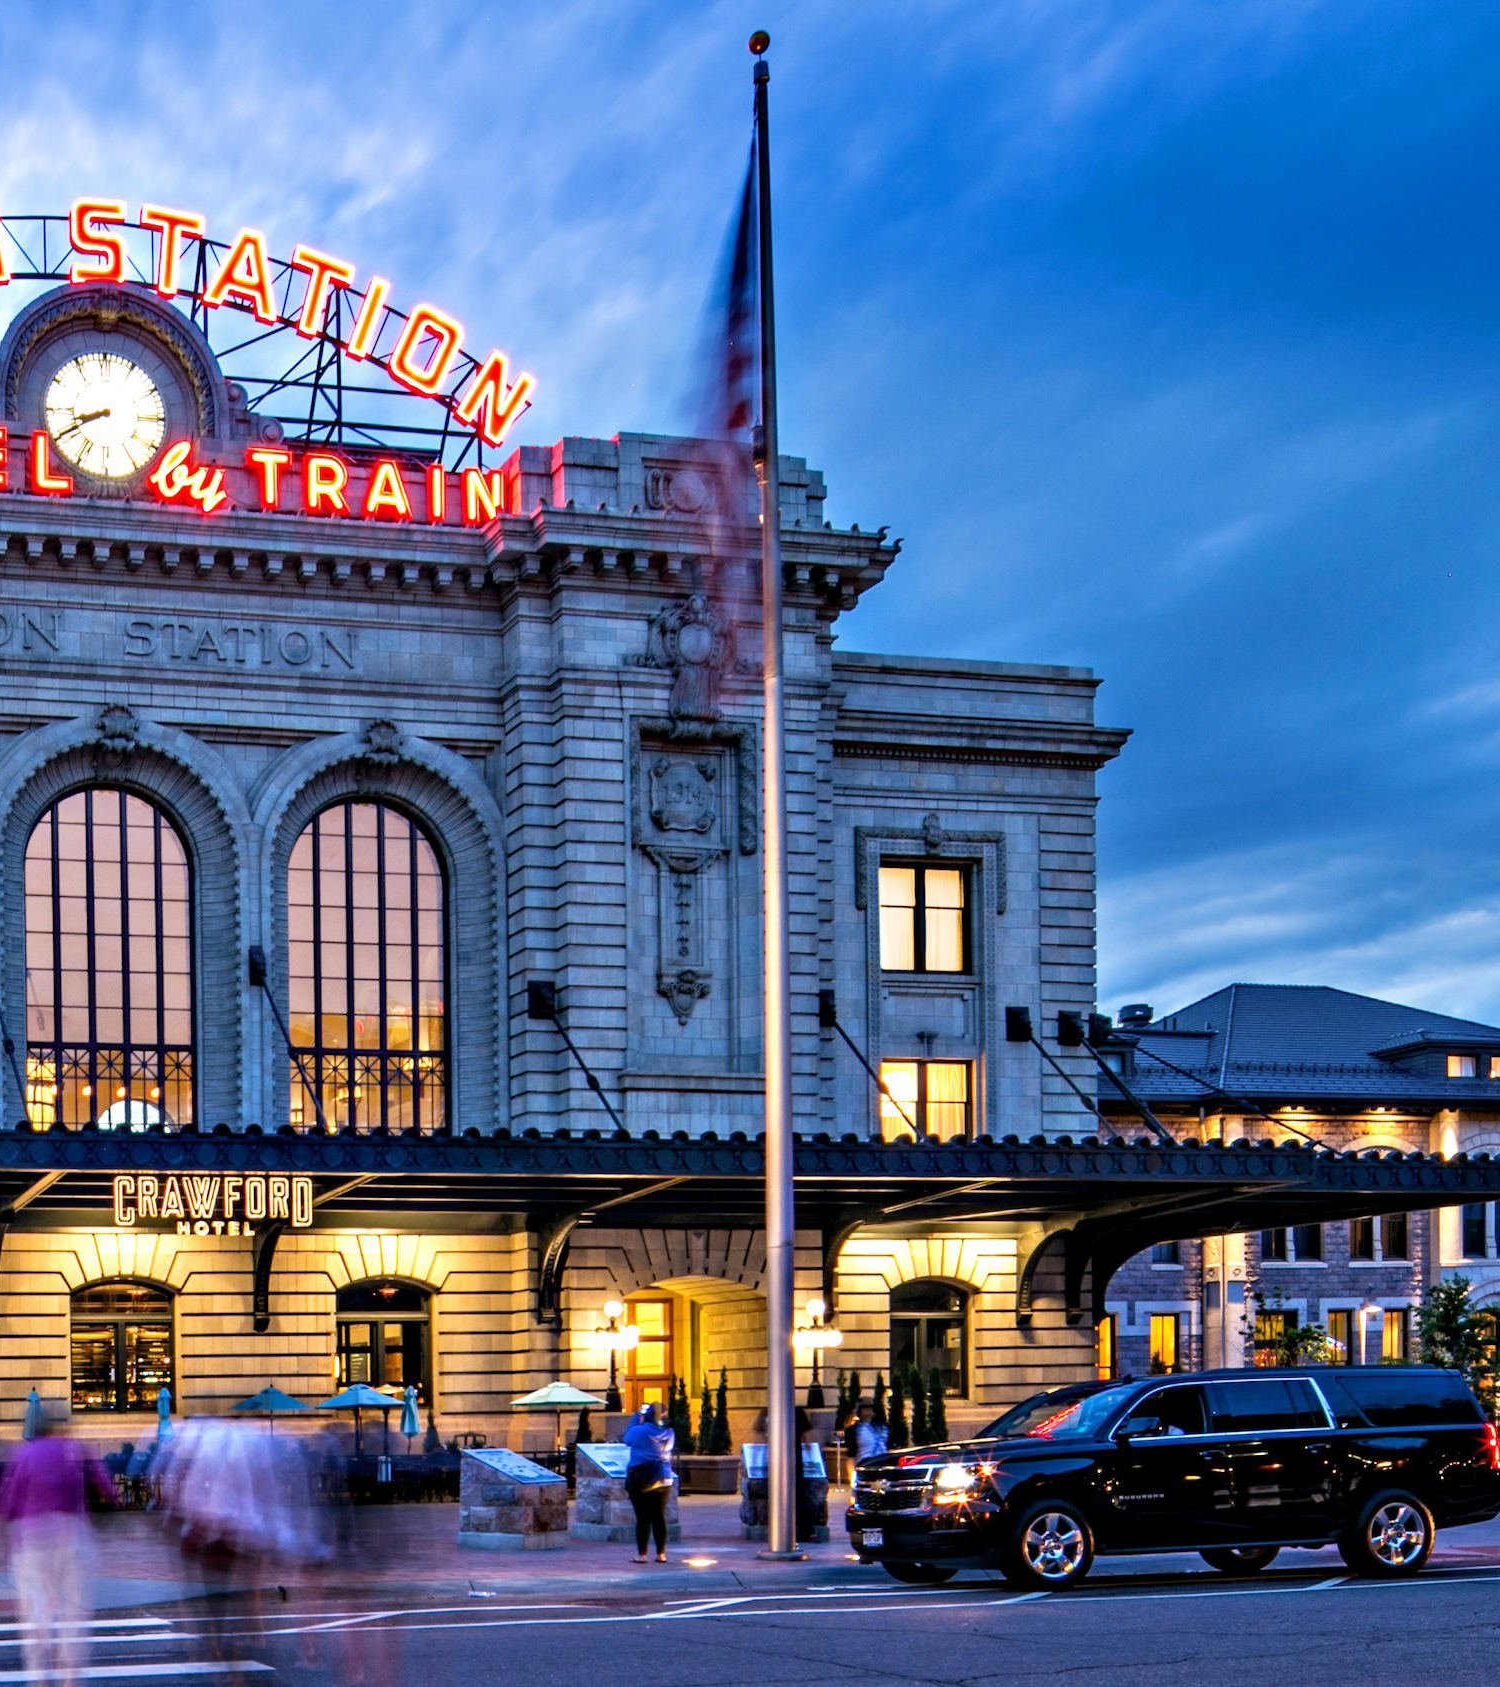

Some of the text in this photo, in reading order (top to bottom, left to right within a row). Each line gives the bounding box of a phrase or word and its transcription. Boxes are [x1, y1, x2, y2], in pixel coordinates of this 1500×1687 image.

[68, 196, 536, 447] STATION
[149, 440, 228, 512] by
[246, 446, 506, 527] TRAIN
[124, 618, 358, 669] STATION
[663, 782, 705, 806] 1914
[113, 1175, 314, 1228] CRAWFORD
[176, 1220, 256, 1237] HOTEL
